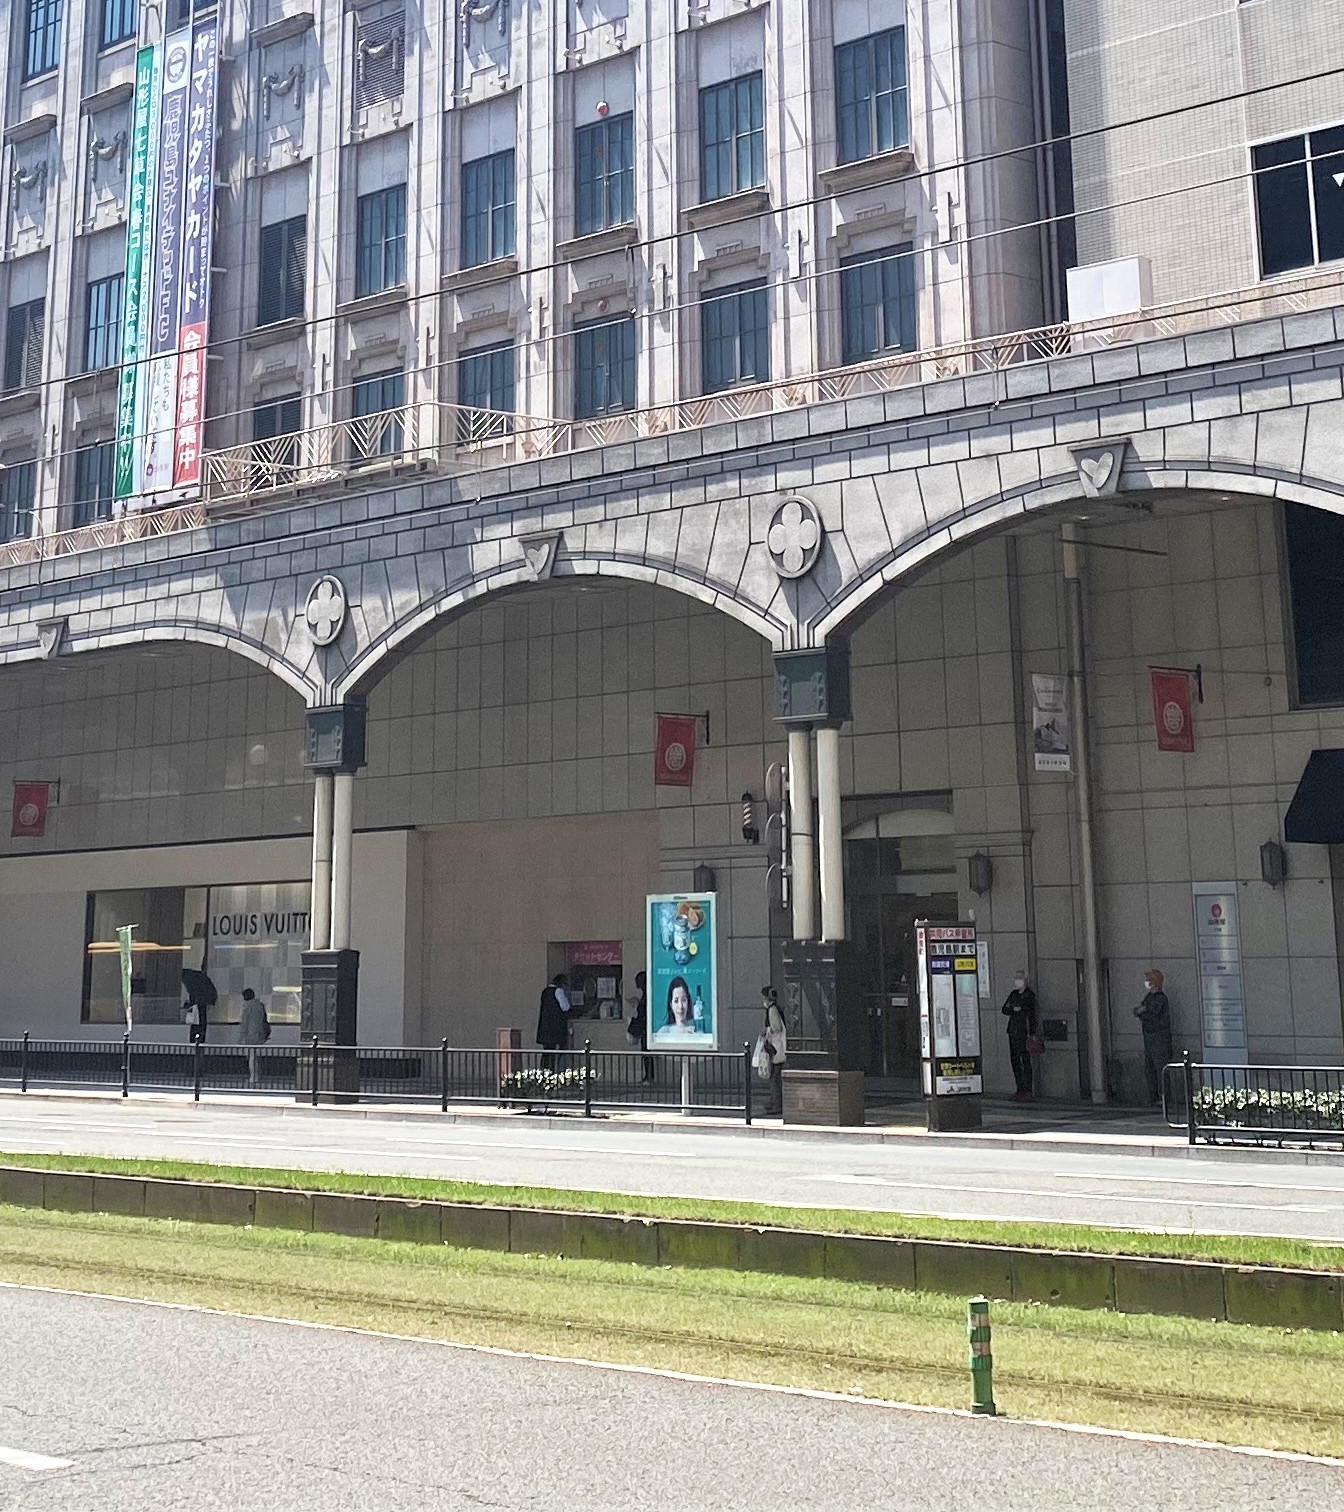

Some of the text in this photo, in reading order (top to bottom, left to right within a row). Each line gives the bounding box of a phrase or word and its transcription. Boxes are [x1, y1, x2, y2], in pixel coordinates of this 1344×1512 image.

[157, 94, 185, 341] 鹿児島ユナイテッドFC
[185, 33, 210, 315] ヤマカタヤカード
[178, 330, 203, 470] 会員様募集中
[212, 912, 312, 936] LOUIS VUITT
